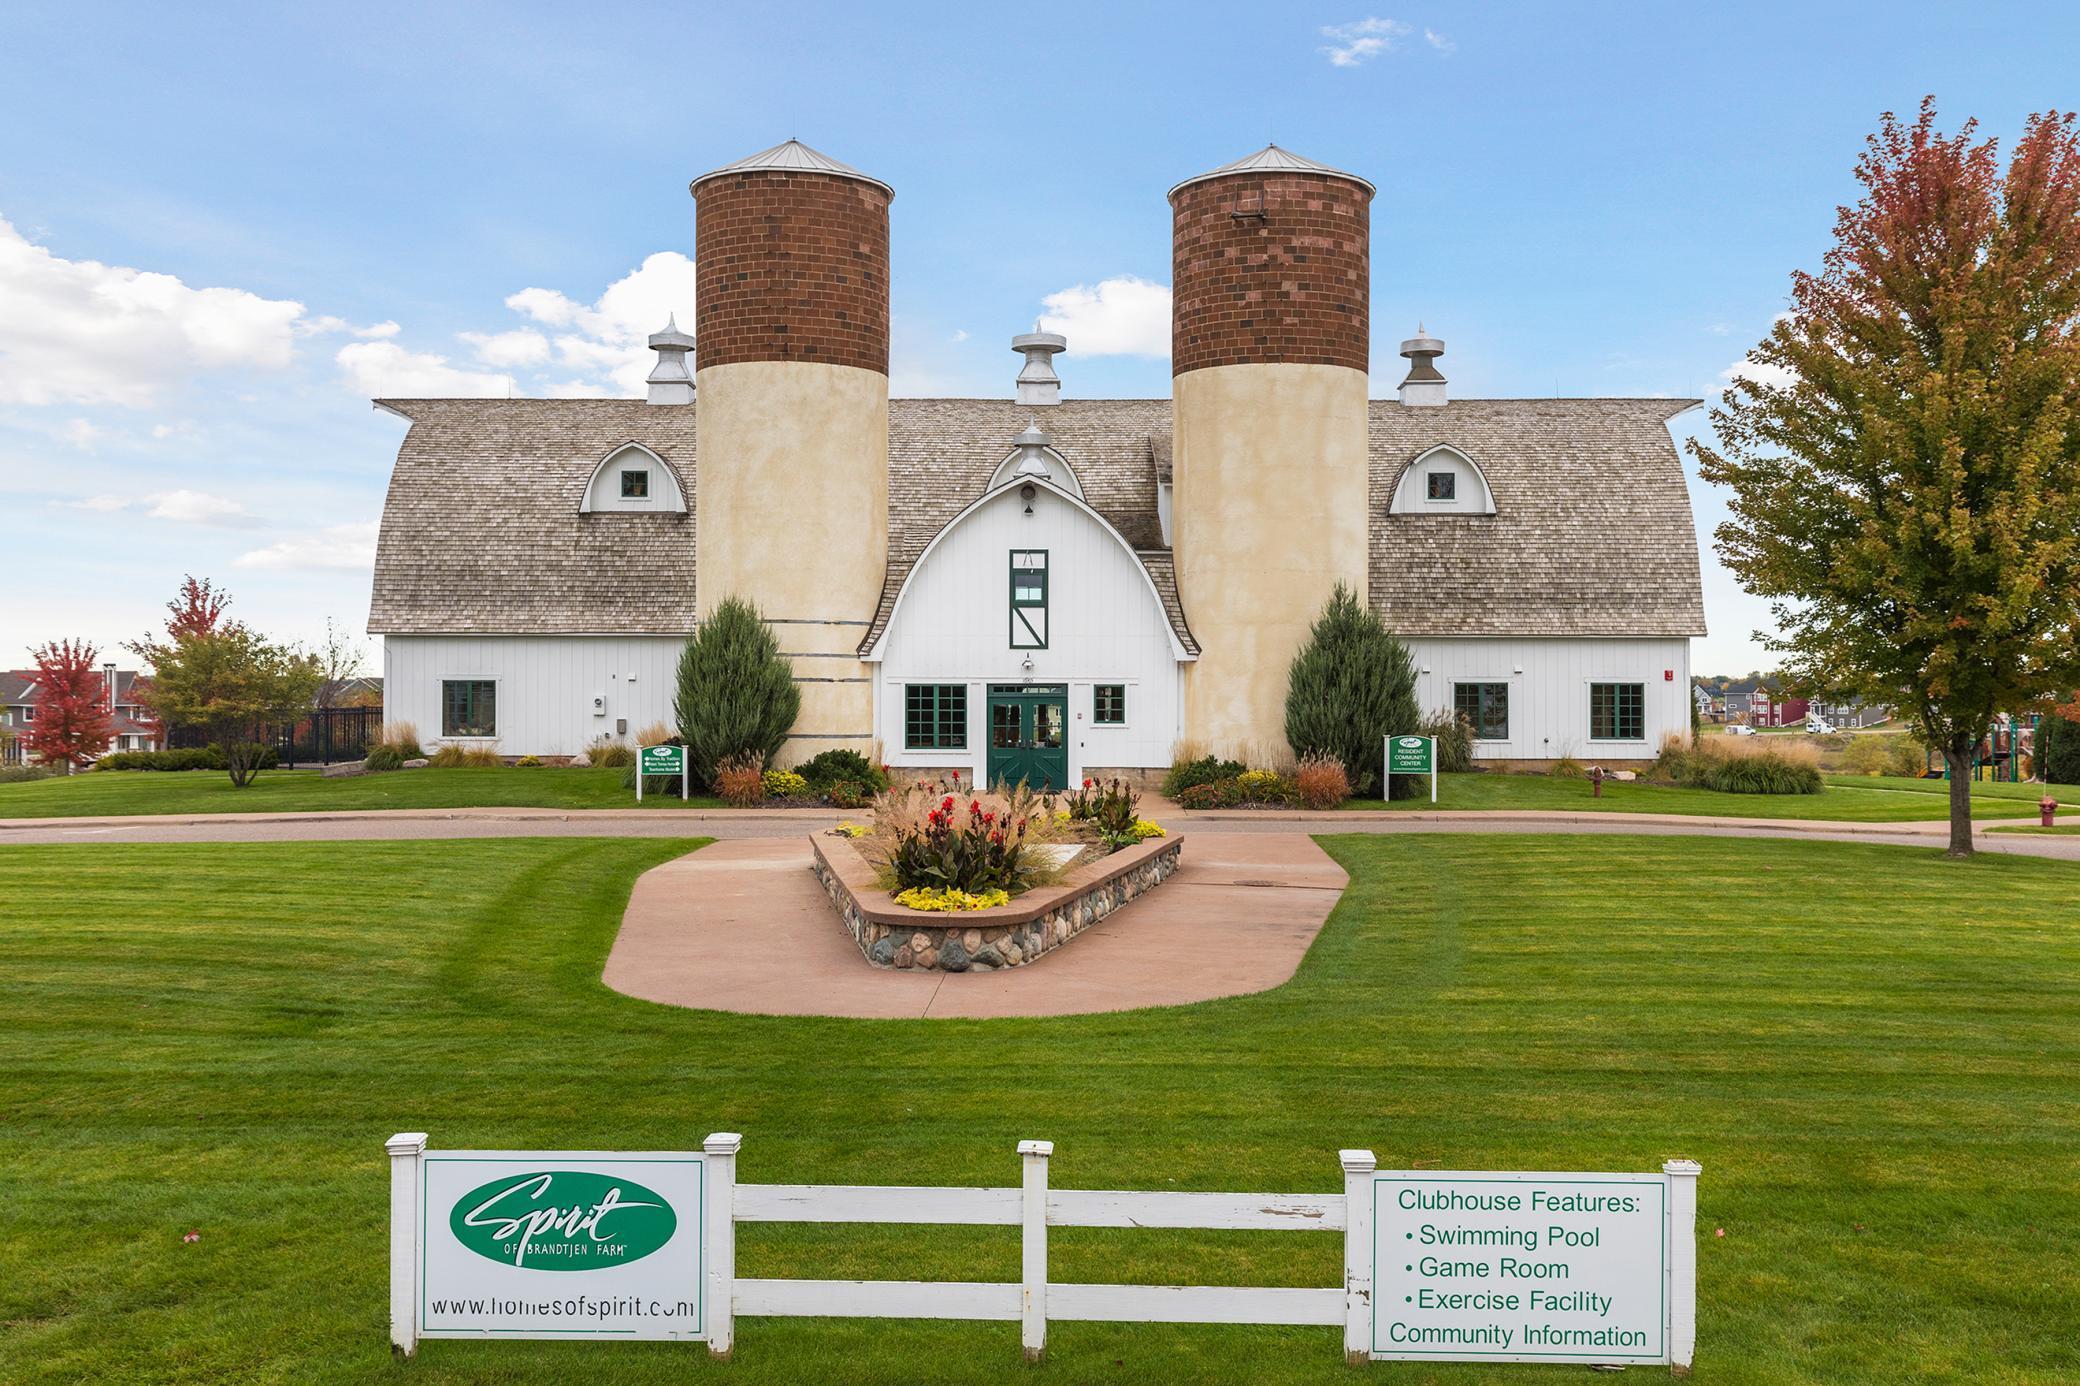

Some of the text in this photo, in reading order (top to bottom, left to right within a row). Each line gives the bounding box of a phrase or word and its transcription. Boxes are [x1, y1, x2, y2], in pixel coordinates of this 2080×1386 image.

[1398, 1188, 1641, 1213] Clubhouse Features:
[464, 1173, 664, 1267] Spirit
[503, 1243, 517, 1256] OF
[526, 1243, 588, 1258] BRANDTJEN
[1419, 1224, 1600, 1251] Swimming Pool
[1419, 1256, 1569, 1279] Game Room
[1418, 1288, 1613, 1317] Exercise Facility
[1389, 1321, 1647, 1349] Community Information
